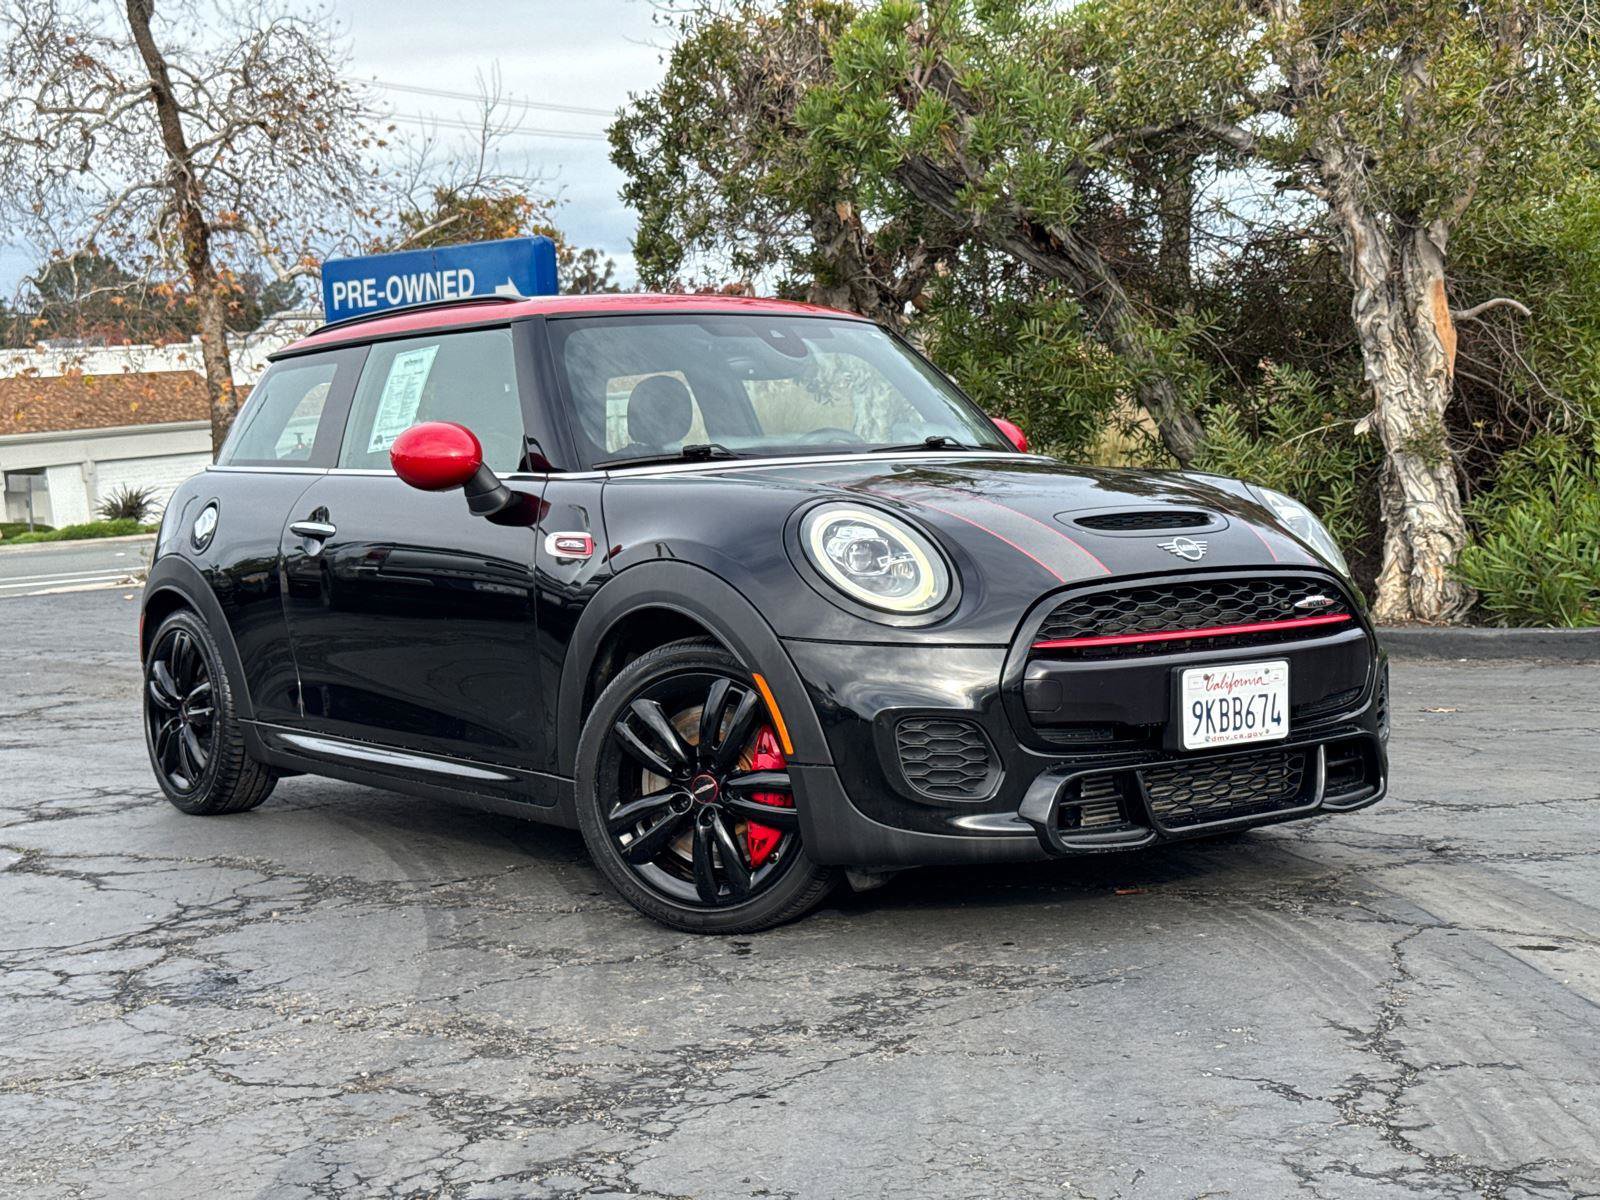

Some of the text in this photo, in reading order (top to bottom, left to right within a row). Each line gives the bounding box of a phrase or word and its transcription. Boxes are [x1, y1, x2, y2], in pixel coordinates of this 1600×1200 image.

[332, 268, 475, 311] PRE-OWNED
[1204, 672, 1270, 695] California
[1192, 692, 1281, 736] 9KBB674
